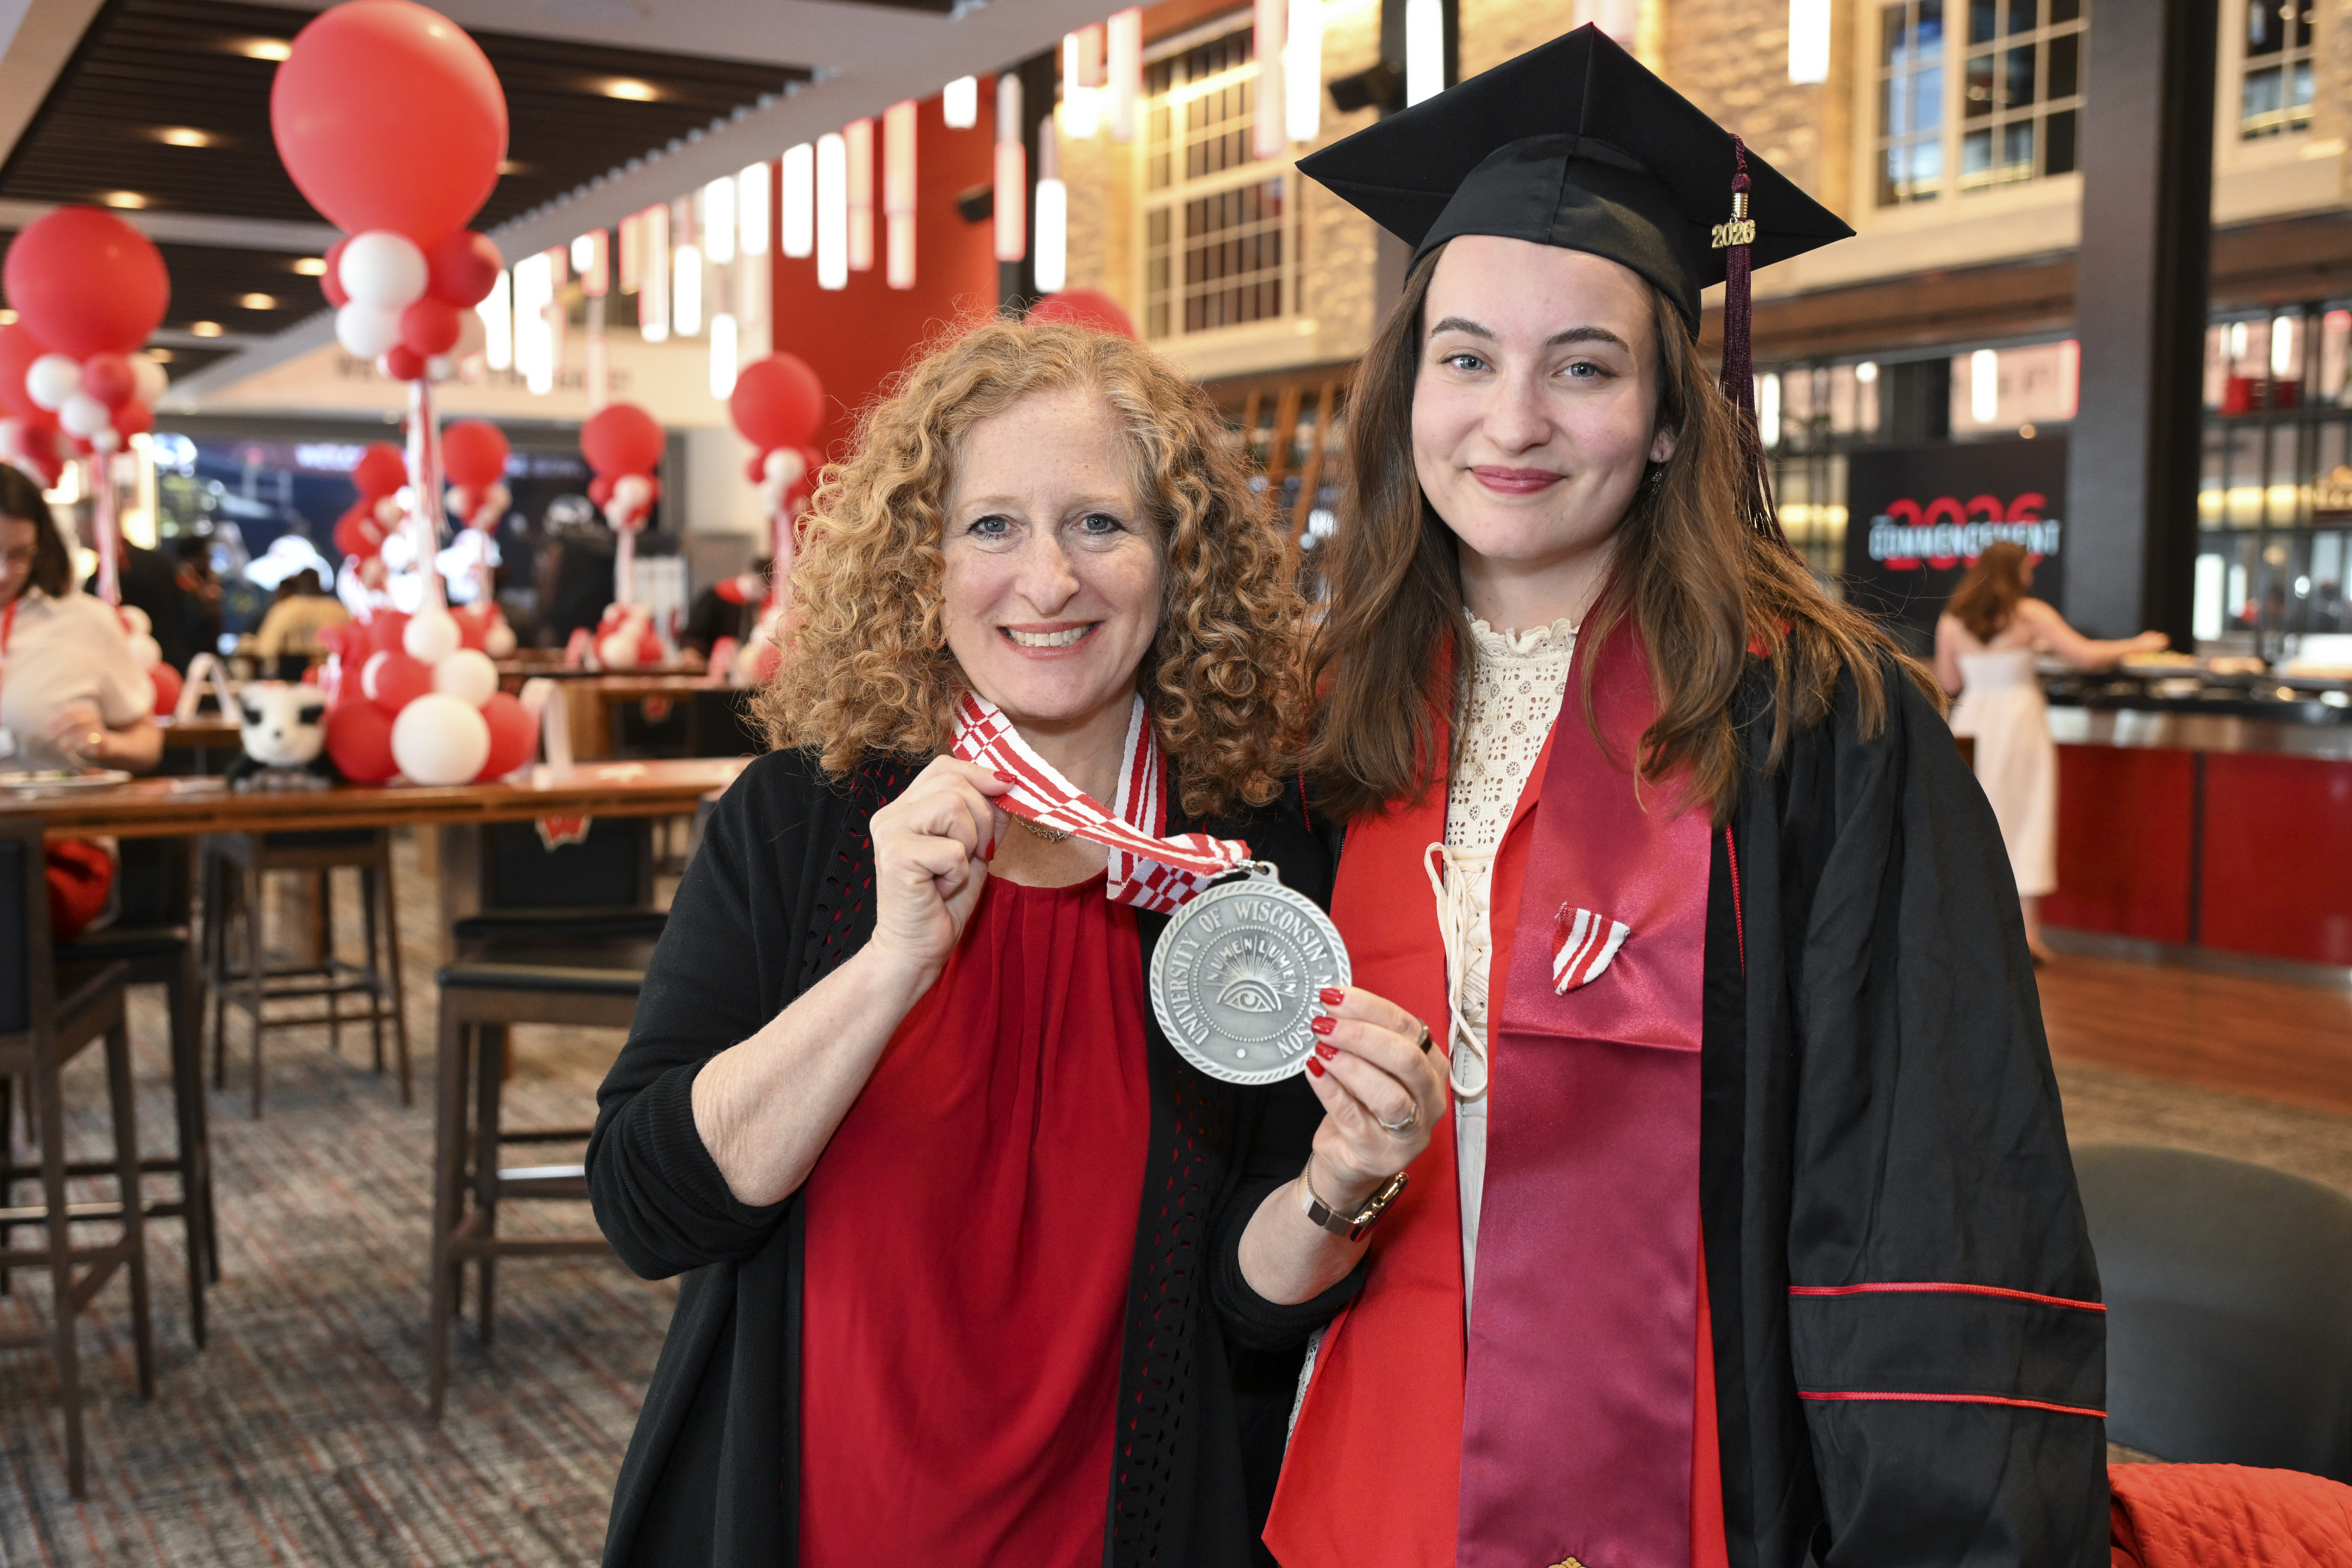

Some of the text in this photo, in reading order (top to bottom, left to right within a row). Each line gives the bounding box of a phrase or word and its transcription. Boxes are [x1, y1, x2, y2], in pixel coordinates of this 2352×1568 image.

[1712, 219, 1755, 248] 2026
[1884, 492, 2047, 570] 2026
[1198, 907, 1223, 933] OF
[1233, 900, 1328, 962] WISCONSIN
[1169, 932, 1210, 1046] UNIVERSITY
[1207, 938, 1297, 993] NUMEN LUMEN
[1276, 974, 1333, 1059] MDSON
